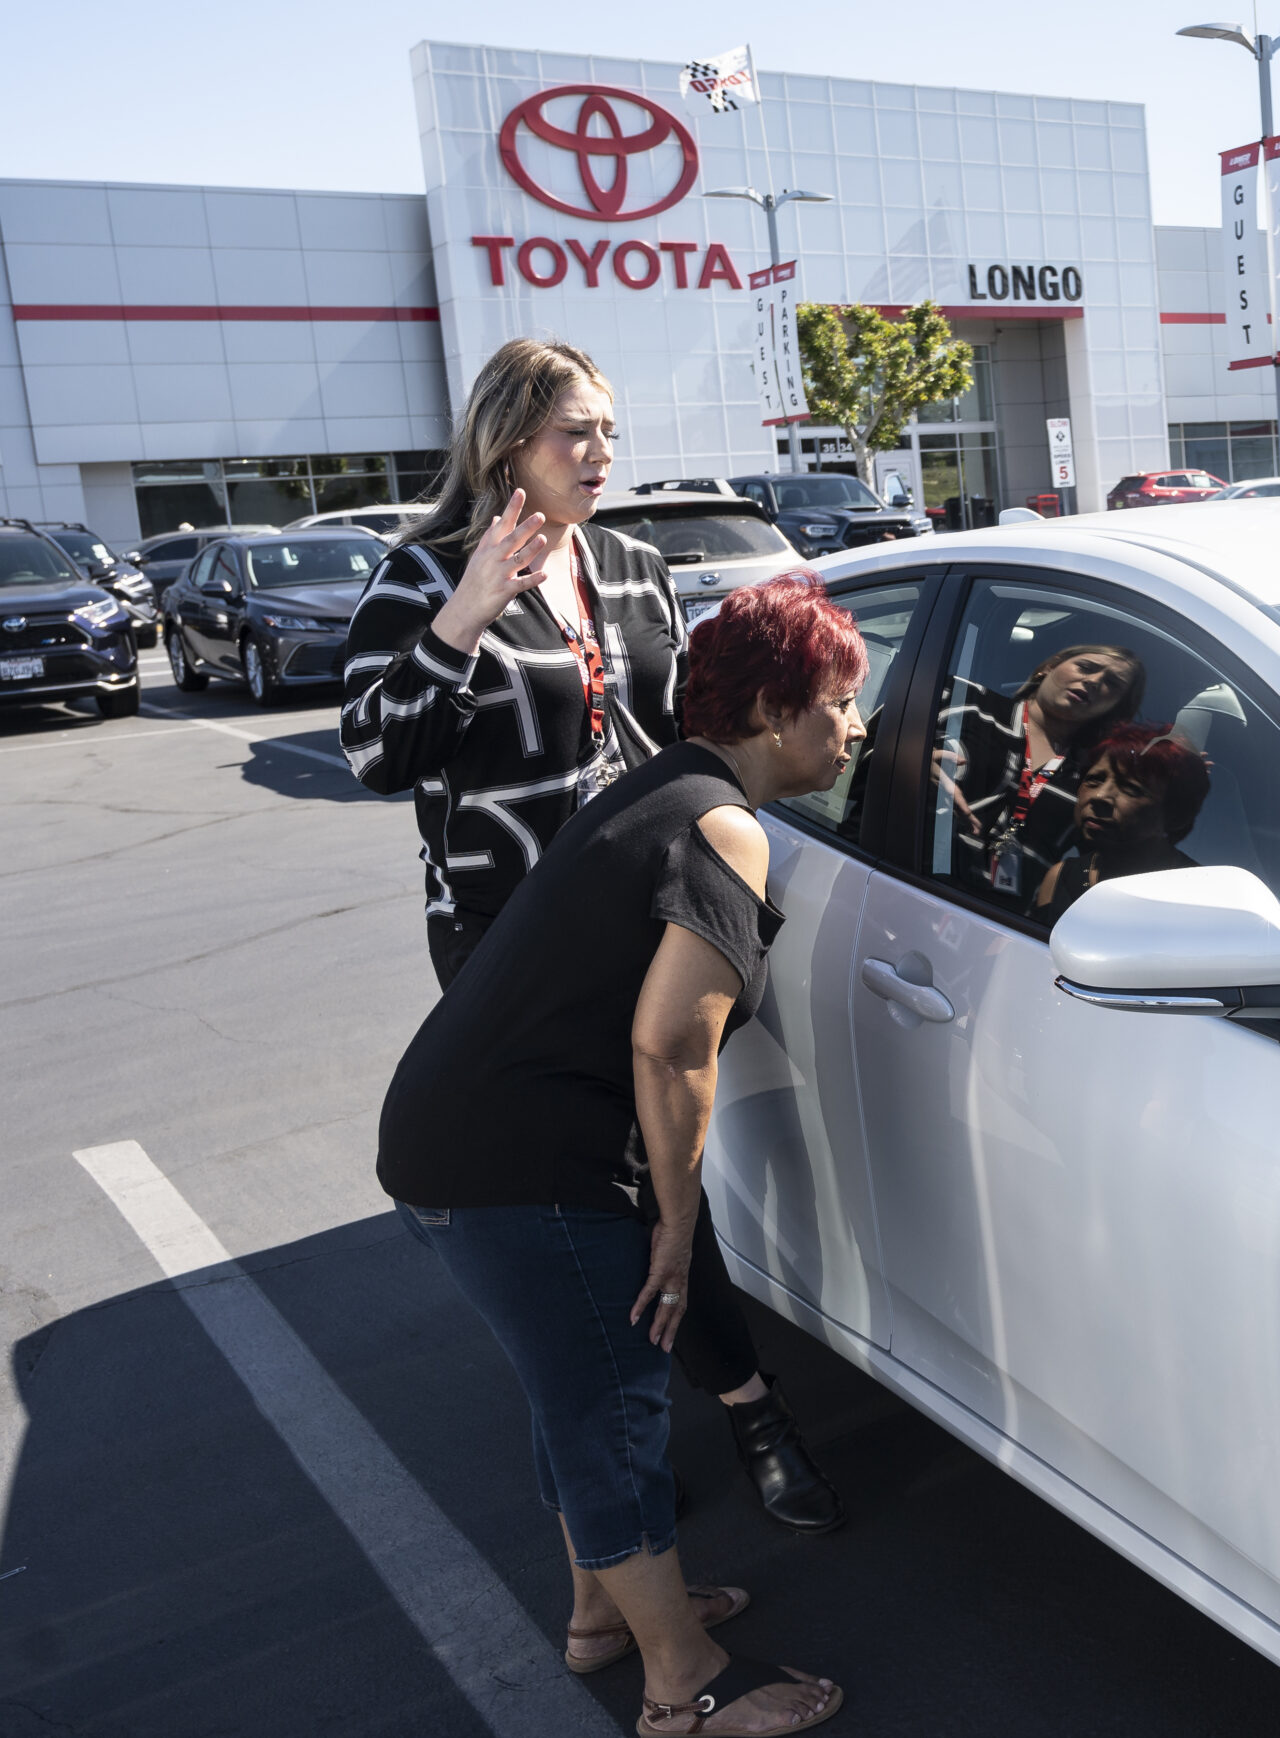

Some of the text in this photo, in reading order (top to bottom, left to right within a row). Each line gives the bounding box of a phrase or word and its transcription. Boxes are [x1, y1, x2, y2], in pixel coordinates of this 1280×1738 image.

[471, 236, 744, 290] TOYOTA
[967, 264, 1082, 301] LONGO
[1233, 184, 1251, 345] GUEST
[757, 298, 771, 409] GUEST
[781, 289, 798, 407] PARKING
[822, 444, 836, 453] 35
[840, 443, 853, 452] 34
[1059, 466, 1069, 480] 5
